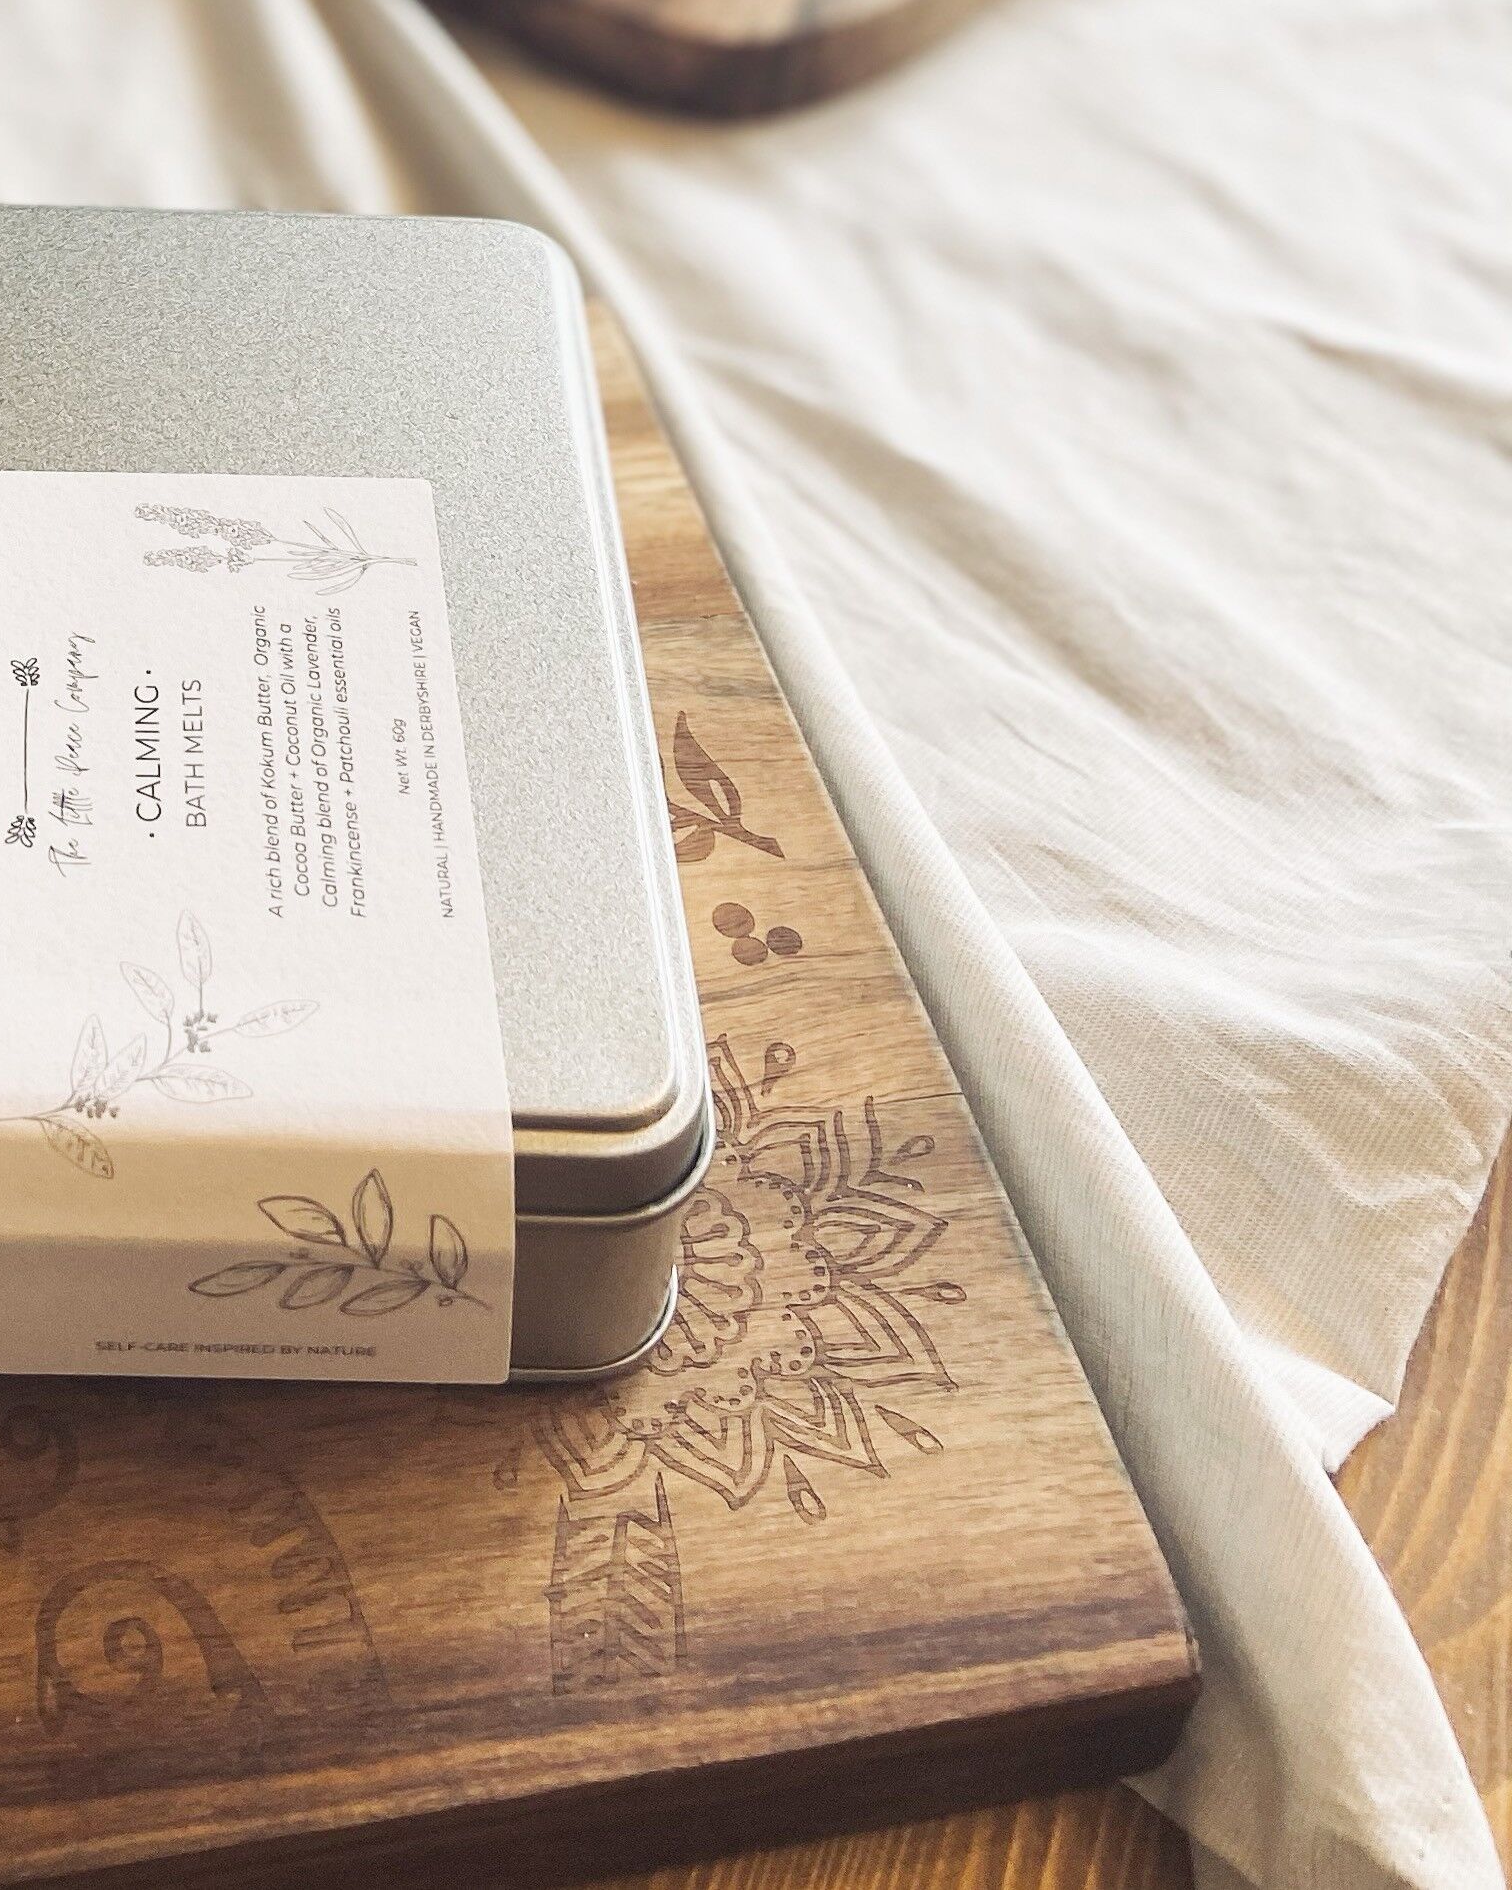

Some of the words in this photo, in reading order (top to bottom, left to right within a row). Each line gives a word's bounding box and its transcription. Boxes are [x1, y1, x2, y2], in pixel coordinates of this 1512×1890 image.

[252, 604, 272, 666] Organic
[278, 622, 292, 634] a
[325, 606, 342, 632] oils
[407, 609, 424, 653] VEGAN
[52, 631, 99, 713] Company
[276, 636, 294, 670] with
[301, 615, 322, 689] Lavender,
[326, 633, 348, 703] essential
[255, 673, 275, 727] Butter,
[278, 672, 296, 695] Oil
[412, 661, 435, 742] DERBYSHIRE
[180, 678, 204, 754] MELTS
[282, 698, 301, 766] Coconut
[309, 692, 329, 757] Organic
[390, 717, 407, 743] 60g
[53, 722, 90, 776] Peace
[133, 684, 162, 822] CALMING
[258, 730, 276, 789] Kokum
[309, 758, 328, 777] of
[333, 706, 354, 784] Patchouli
[422, 744, 436, 758] IN
[47, 787, 93, 827] Little
[183, 762, 207, 828] BATH
[259, 790, 278, 810] of
[289, 782, 306, 837] Butter
[312, 779, 332, 829] blend
[396, 770, 410, 795] Net
[423, 761, 444, 841] HANDMADE
[47, 838, 90, 877] The
[261, 812, 281, 863] blend
[344, 800, 366, 918] Frankincense
[265, 866, 282, 900] rich
[292, 841, 311, 897] Cocoa
[319, 832, 338, 908] Calming
[435, 852, 454, 918] NATURAL
[267, 904, 283, 918] A
[94, 1340, 189, 1353] SELF-CARE
[193, 1342, 275, 1355] INSPIRED
[279, 1345, 302, 1356] BY
[307, 1345, 378, 1358] NATURE
